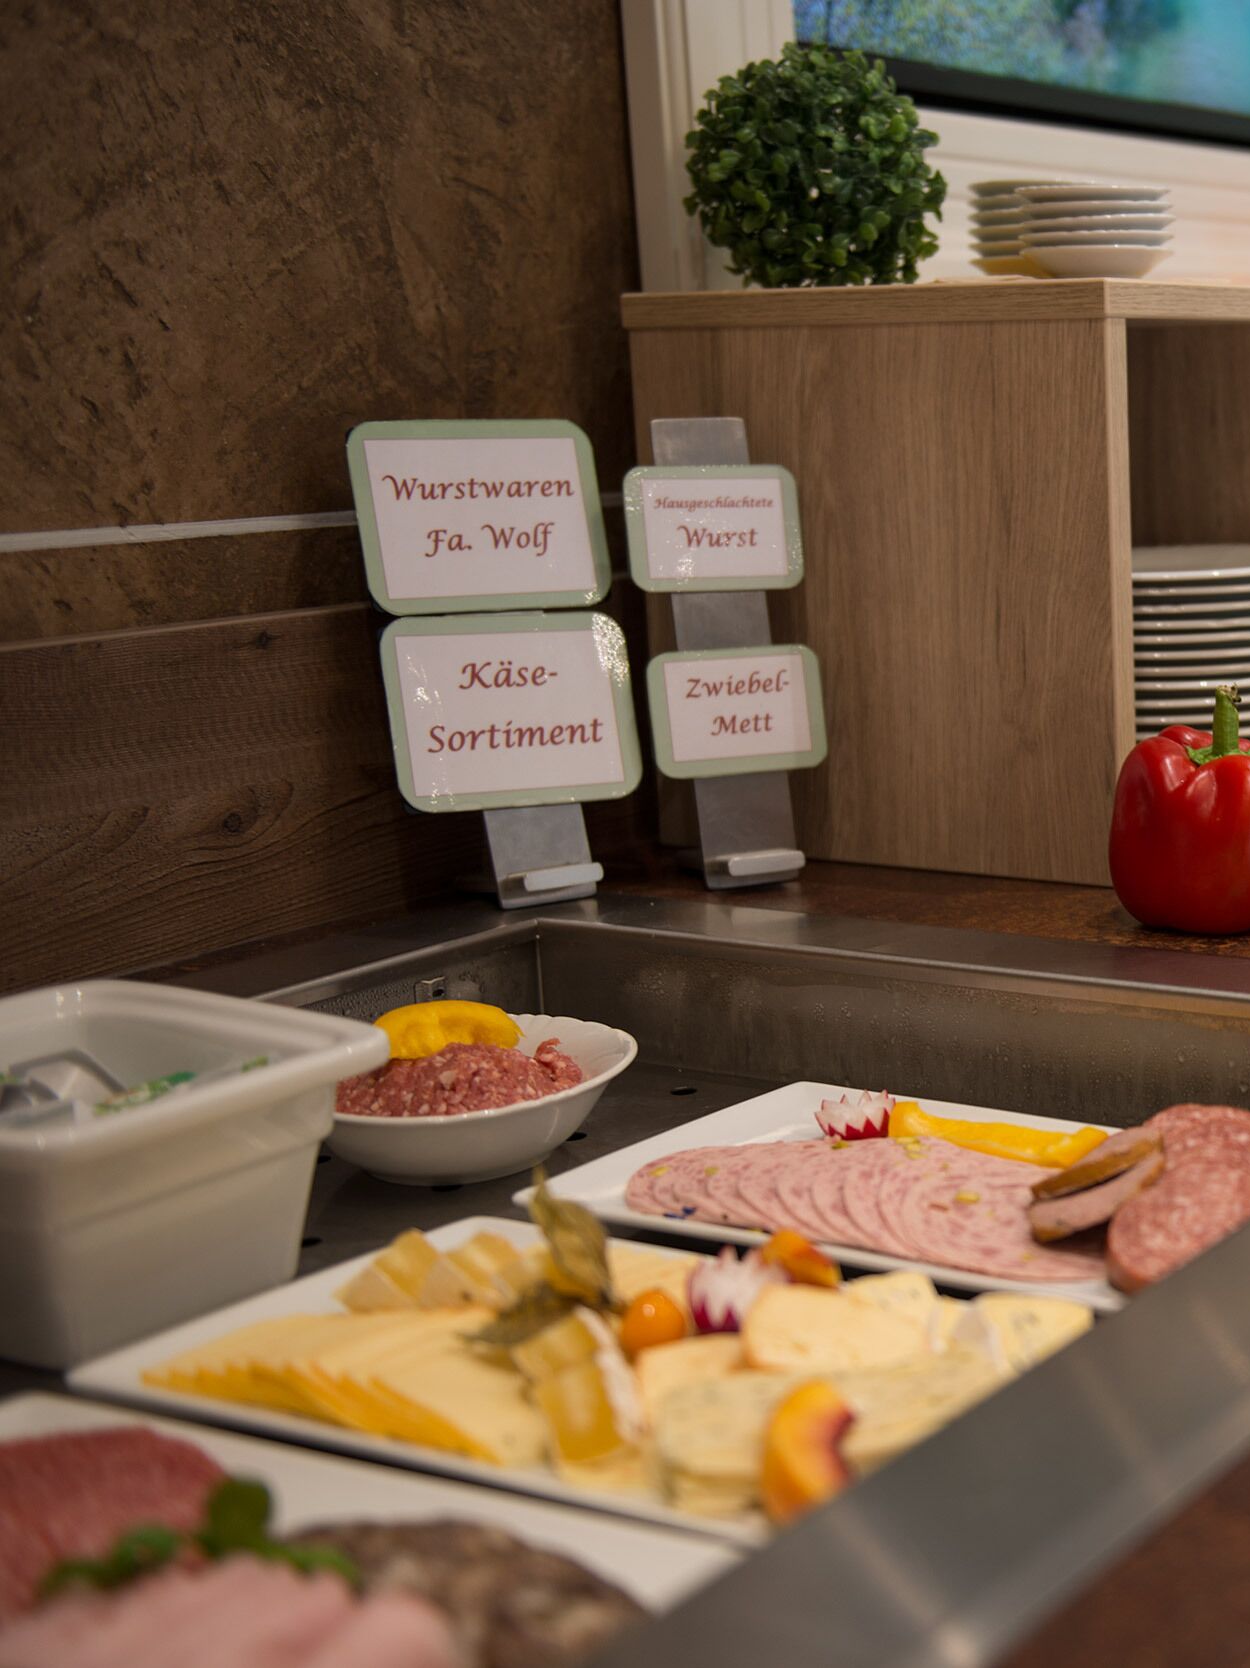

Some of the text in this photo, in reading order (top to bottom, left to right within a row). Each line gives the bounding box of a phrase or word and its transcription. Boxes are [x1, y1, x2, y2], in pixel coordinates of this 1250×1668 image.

[382, 475, 575, 500] Wurstwaren
[653, 496, 774, 512] Hausgeschlachtete
[425, 522, 555, 557] Fa. Wolf
[677, 525, 759, 548] Wurst
[458, 661, 558, 690] Käse-
[427, 718, 604, 754] Sortiment
[711, 713, 773, 736] Mett
